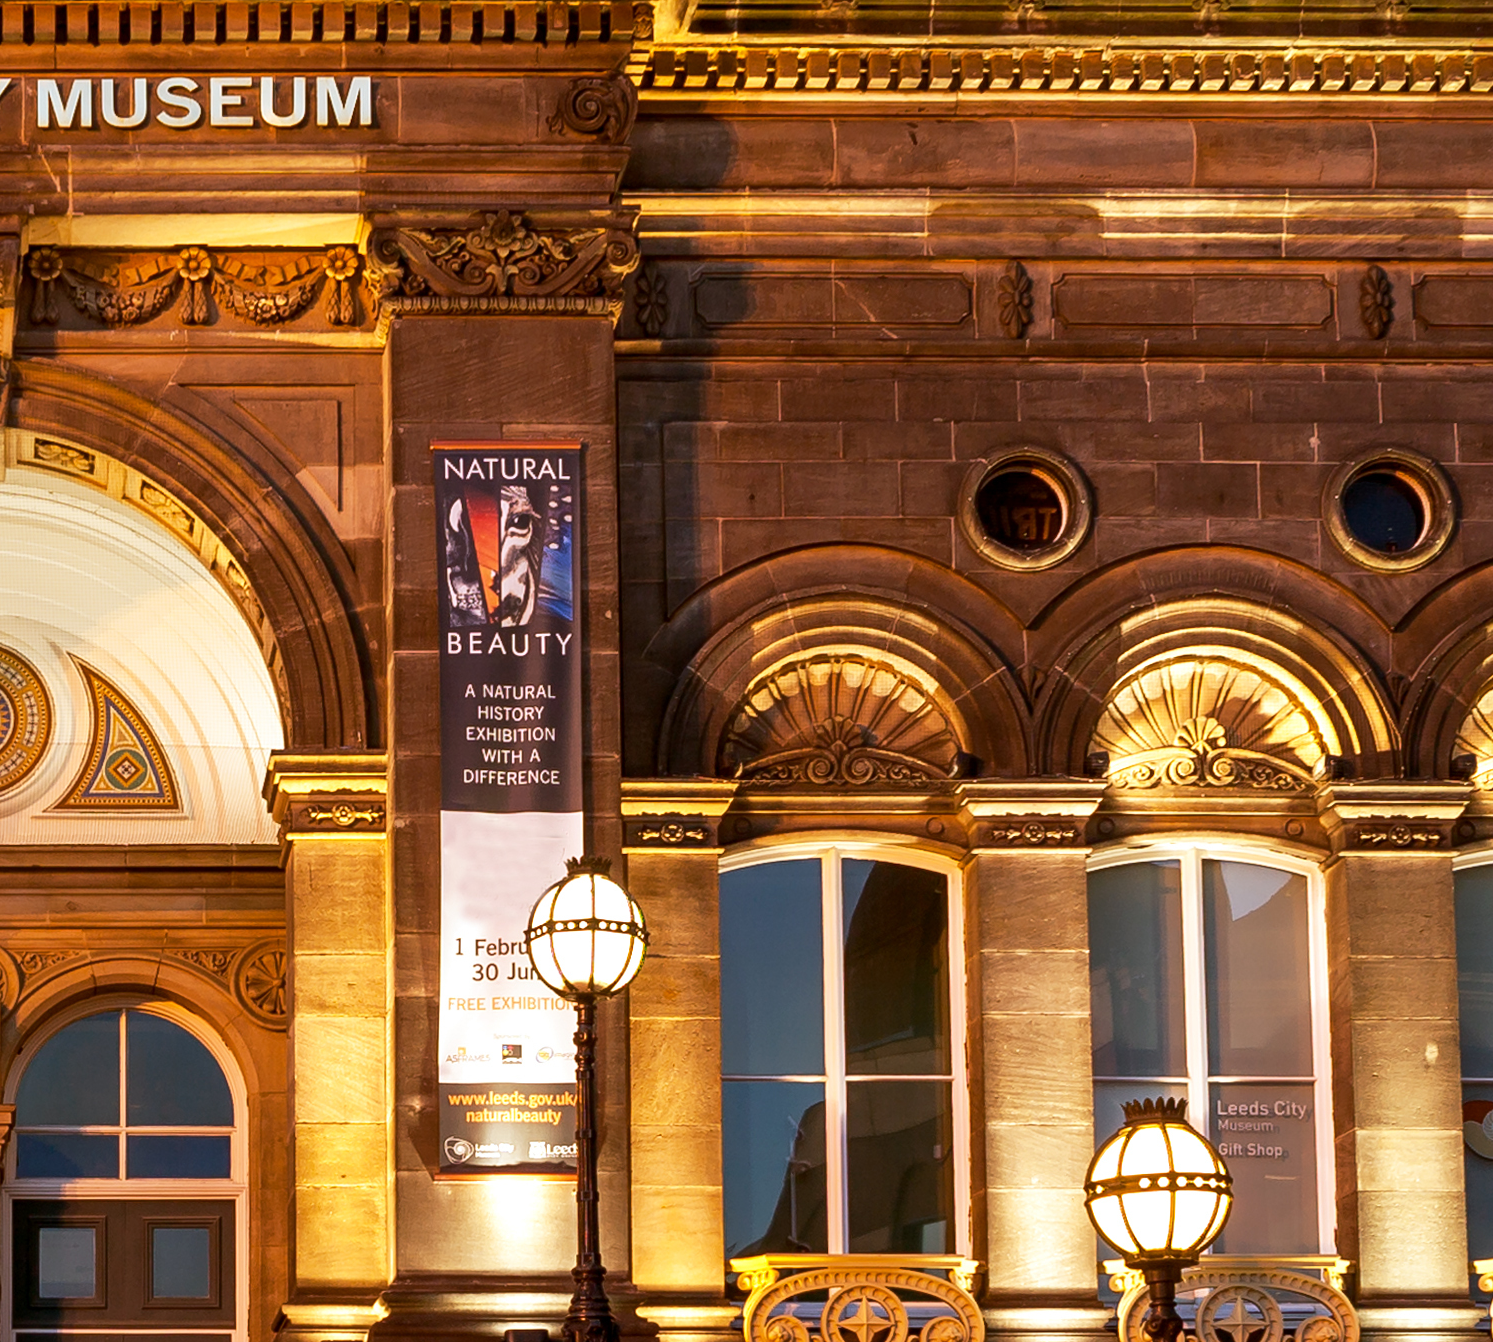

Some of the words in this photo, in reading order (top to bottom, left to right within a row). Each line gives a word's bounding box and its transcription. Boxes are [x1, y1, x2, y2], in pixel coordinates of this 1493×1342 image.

[37, 76, 374, 130] MUSEUM
[443, 457, 571, 481] NATURAL
[446, 631, 573, 657] BEAUTY
[464, 683, 476, 698] A
[482, 683, 556, 700] NATURAL
[477, 705, 545, 722] HISTORY
[466, 726, 556, 742] EXHIBITION
[481, 747, 523, 764] WITH
[529, 747, 541, 763] A
[463, 769, 560, 786] DIFFERENCE
[455, 938, 464, 956] 1
[475, 938, 529, 957] Febru
[472, 963, 499, 981] 30
[507, 962, 541, 981] Jun
[448, 997, 486, 1011] FREE
[466, 1108, 561, 1125] naturalbeauty
[1217, 1100, 1269, 1115] Leeds
[1274, 1100, 1307, 1119] City
[1218, 1119, 1273, 1131] Museum
[1218, 1143, 1242, 1156] Gift
[1247, 1143, 1283, 1159] Shop
